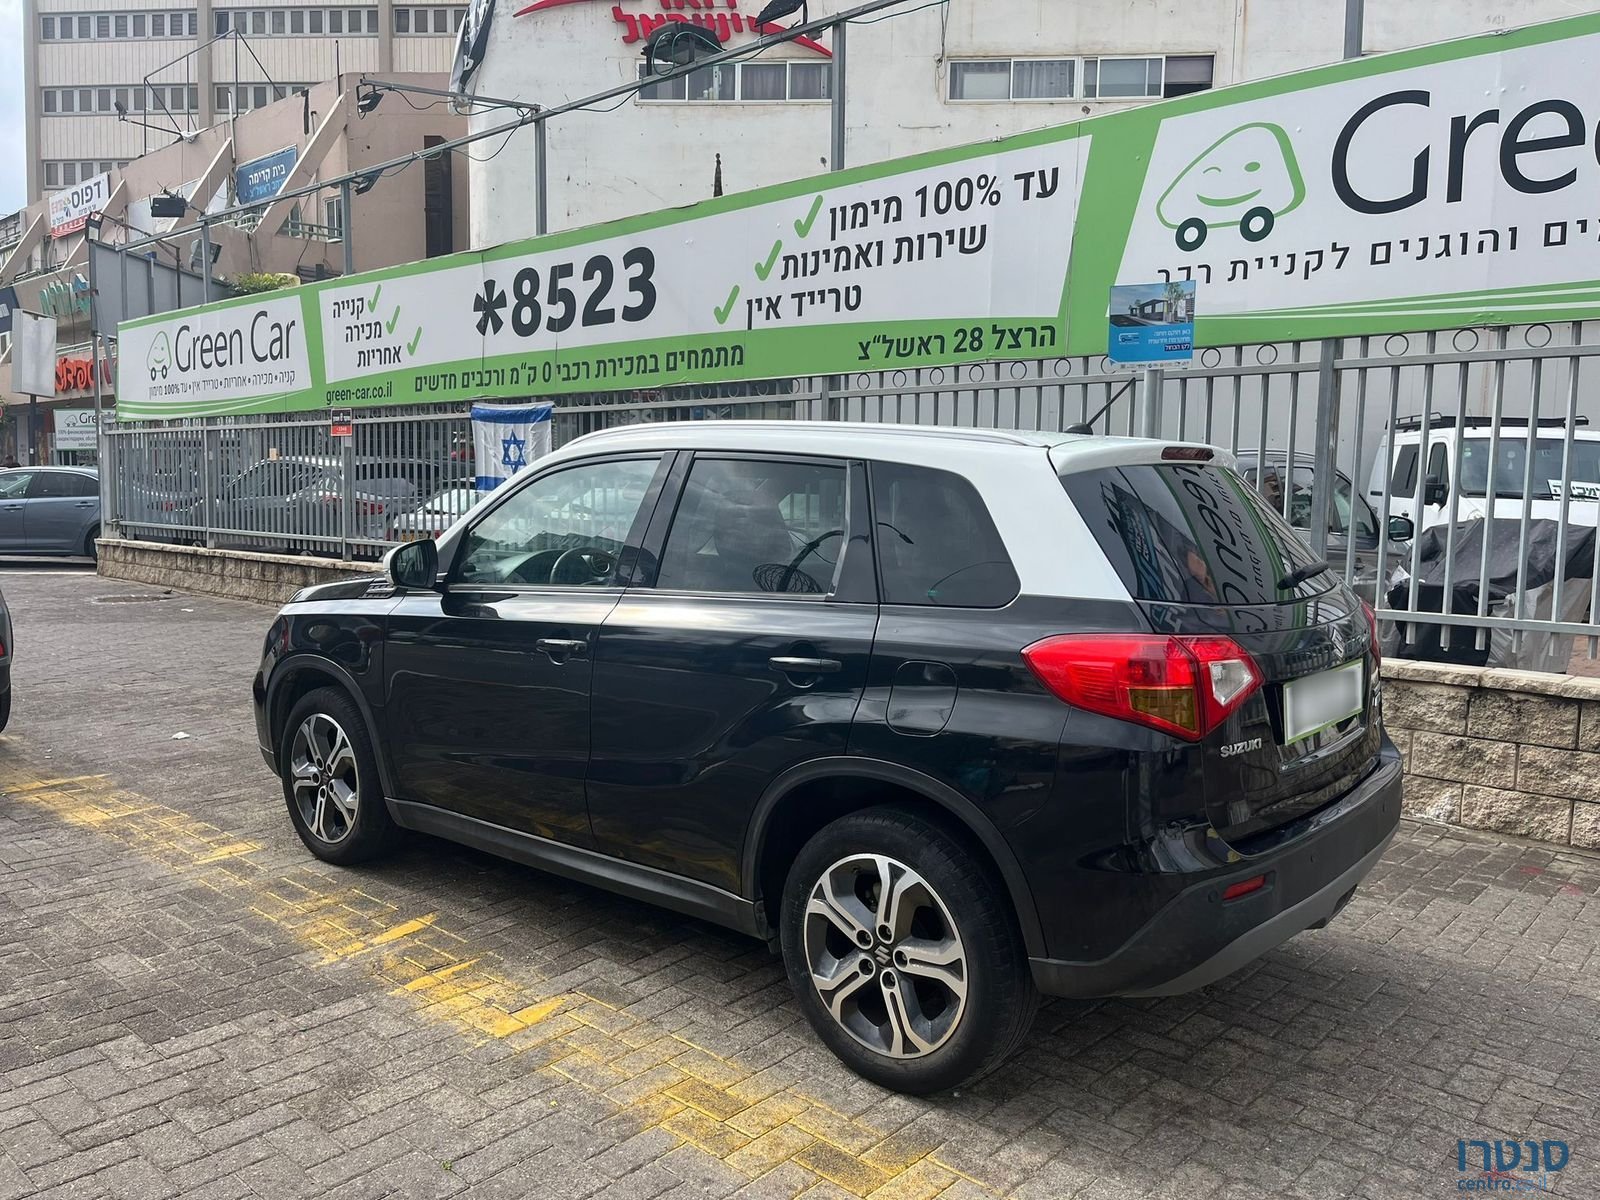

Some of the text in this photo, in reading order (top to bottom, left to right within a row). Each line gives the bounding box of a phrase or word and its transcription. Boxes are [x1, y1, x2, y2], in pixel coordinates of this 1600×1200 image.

[1331, 89, 1600, 214] Gre
[272, 164, 286, 177] בית
[71, 180, 102, 208] דפוס
[830, 167, 1060, 241] עד 100% מימון
[1544, 218, 1600, 247] ים
[780, 224, 987, 280] שירות ואמינות
[1370, 226, 1518, 266] והוגנים
[1228, 242, 1350, 282] לקניית
[333, 297, 364, 320] קנייה
[747, 284, 862, 330] טרייד אין
[176, 310, 296, 372] Green Car
[346, 321, 382, 343] מכירה
[953, 326, 984, 353] 28
[992, 324, 1056, 350] הרצל
[358, 346, 402, 368] אחריות
[594, 353, 660, 379] במכירת
[666, 344, 744, 372] מתמחים
[252, 372, 273, 385] מכירה
[279, 370, 296, 386] קניה
[414, 372, 457, 392] חדשים
[461, 368, 505, 389] ורכבים
[542, 361, 552, 384] 0
[556, 360, 590, 383] רכבי
[164, 384, 180, 395] 100%
[326, 380, 392, 406] green-car.co.il
[1220, 738, 1262, 758] SUZUKI
